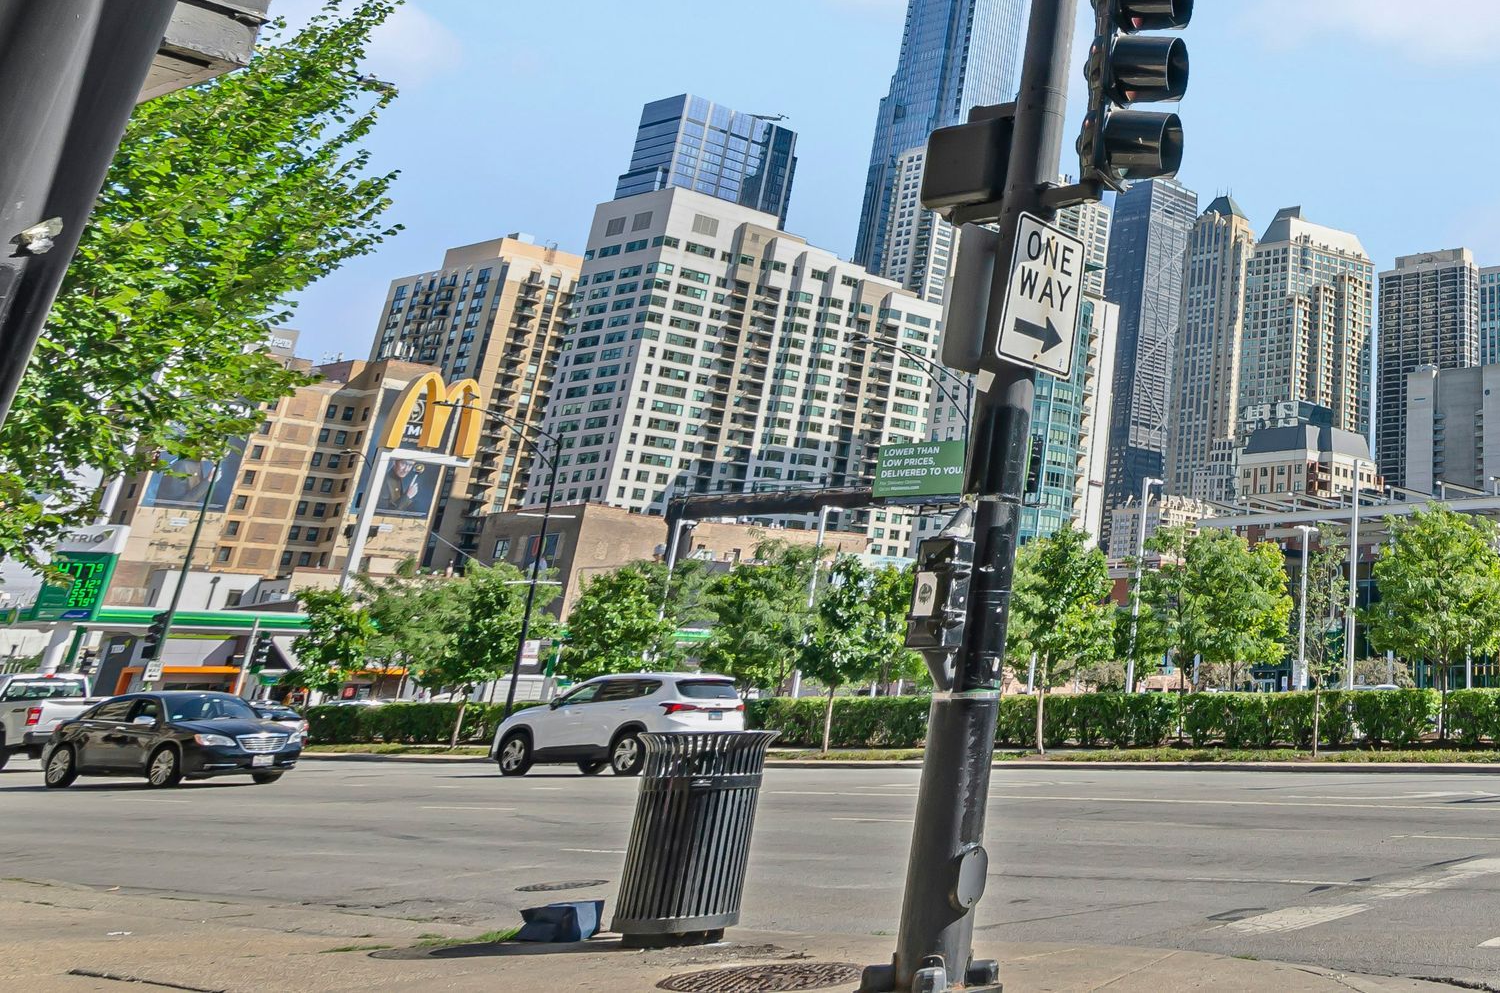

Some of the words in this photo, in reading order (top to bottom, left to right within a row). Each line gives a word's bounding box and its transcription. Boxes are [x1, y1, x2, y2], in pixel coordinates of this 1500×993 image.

[1027, 230, 1074, 277] ONE
[1019, 265, 1072, 312] WAY
[884, 447, 915, 457] LOWER
[916, 446, 940, 455] THAN
[882, 458, 902, 468] LOW
[904, 457, 936, 466] PRICES,
[880, 469, 927, 478] DELIVERED
[929, 467, 941, 476] TO
[943, 466, 963, 475] YOU.
